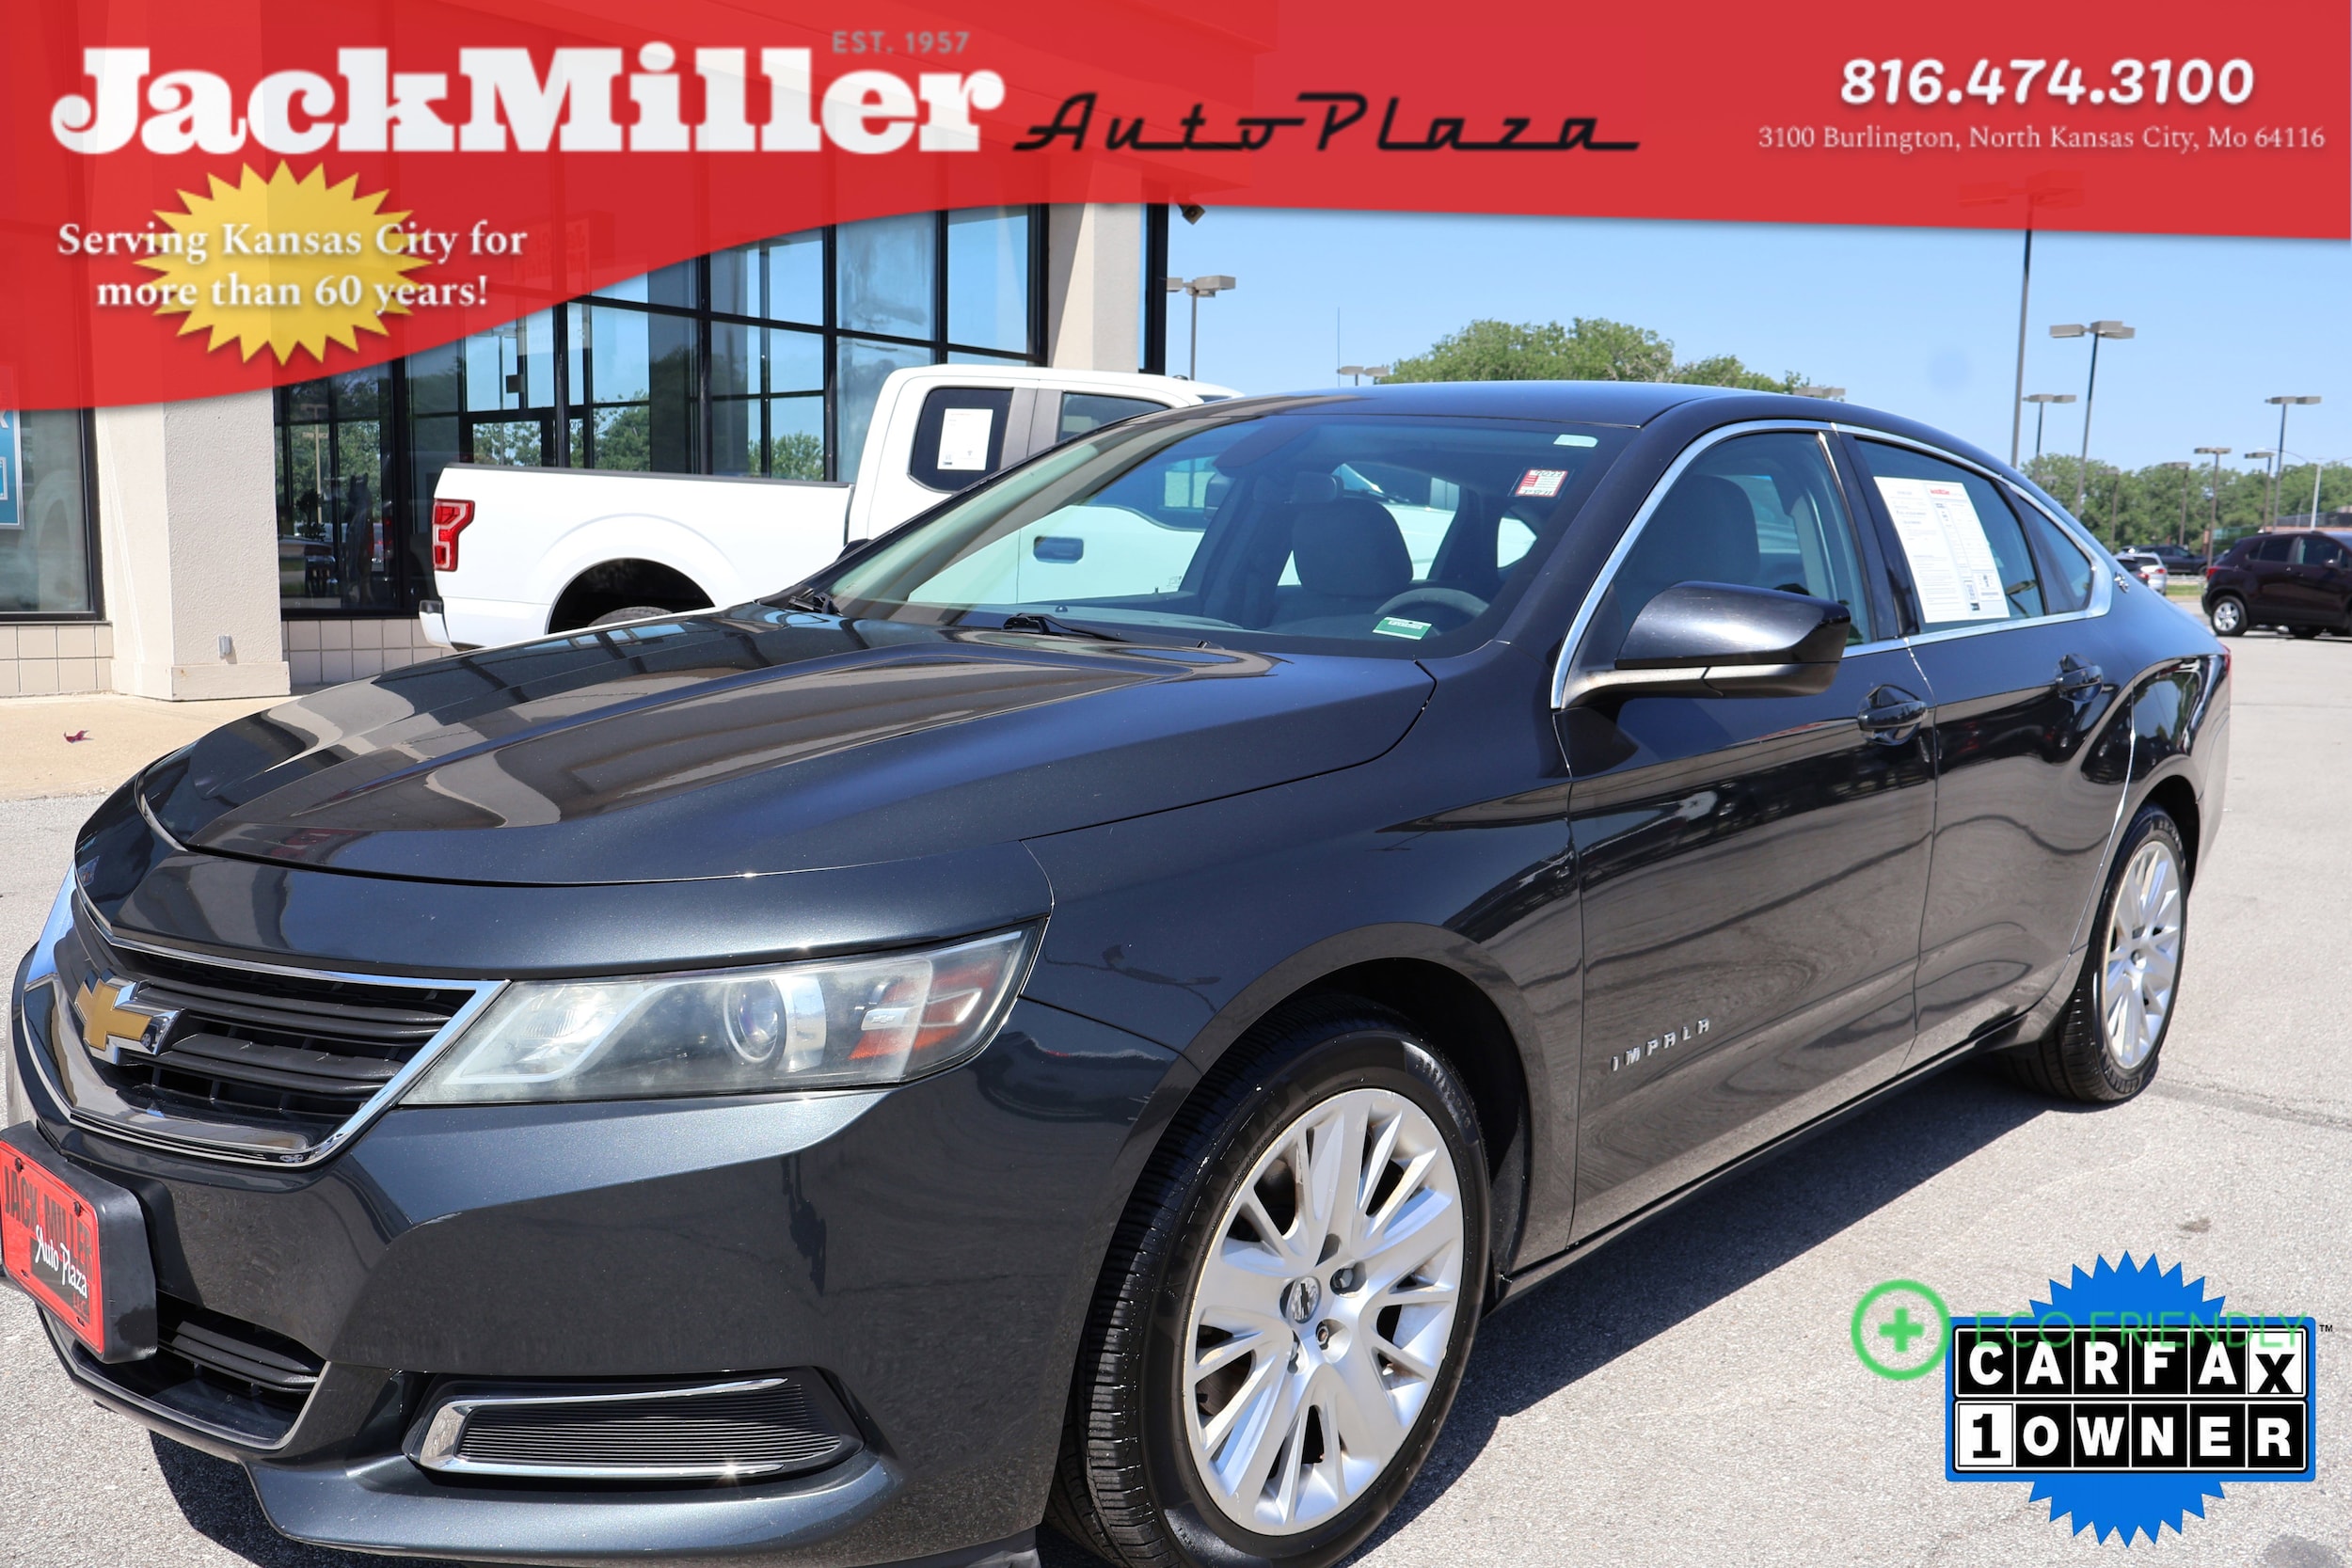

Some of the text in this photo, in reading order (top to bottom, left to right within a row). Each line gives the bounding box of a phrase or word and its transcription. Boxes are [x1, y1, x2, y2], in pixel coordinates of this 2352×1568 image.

[1612, 1018, 1709, 1071] IMPALA
[4, 1165, 40, 1234] JACK
[34, 1224, 88, 1299] Auto Plaza
